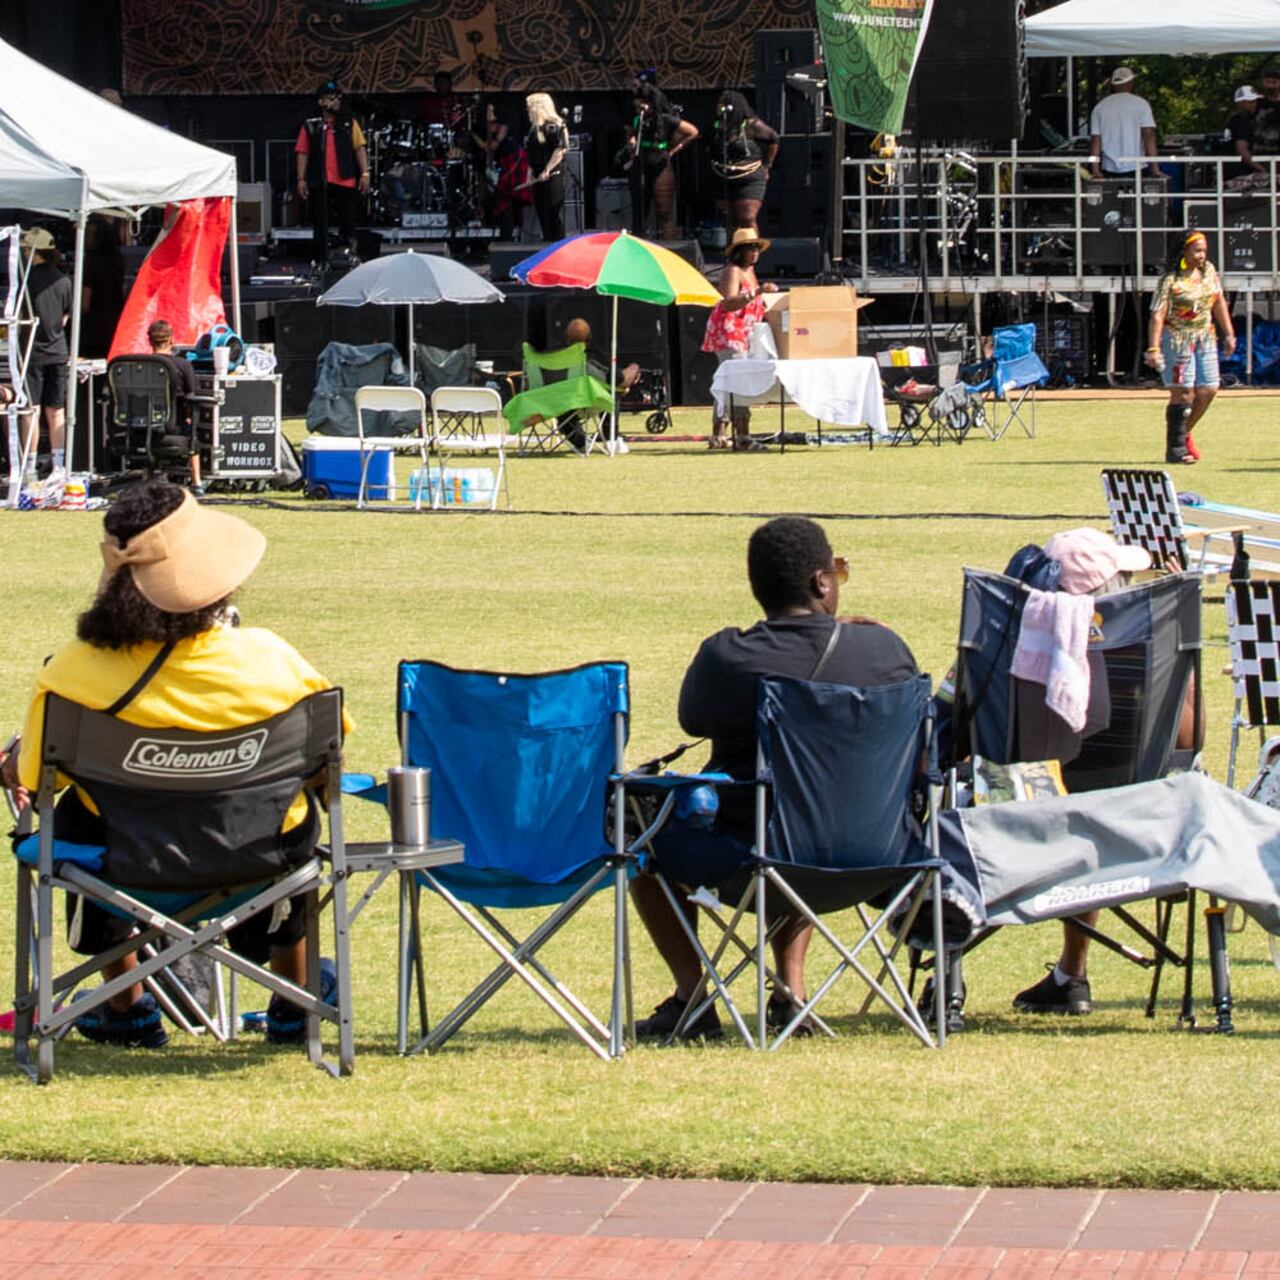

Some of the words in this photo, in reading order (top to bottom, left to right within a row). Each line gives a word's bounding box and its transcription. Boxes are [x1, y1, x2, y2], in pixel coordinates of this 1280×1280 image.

[833, 12, 923, 28] WWW.JUNETEENT
[232, 442, 266, 452] VIDEO
[226, 456, 272, 466] WORKBOX
[137, 744, 236, 768] Coleman
